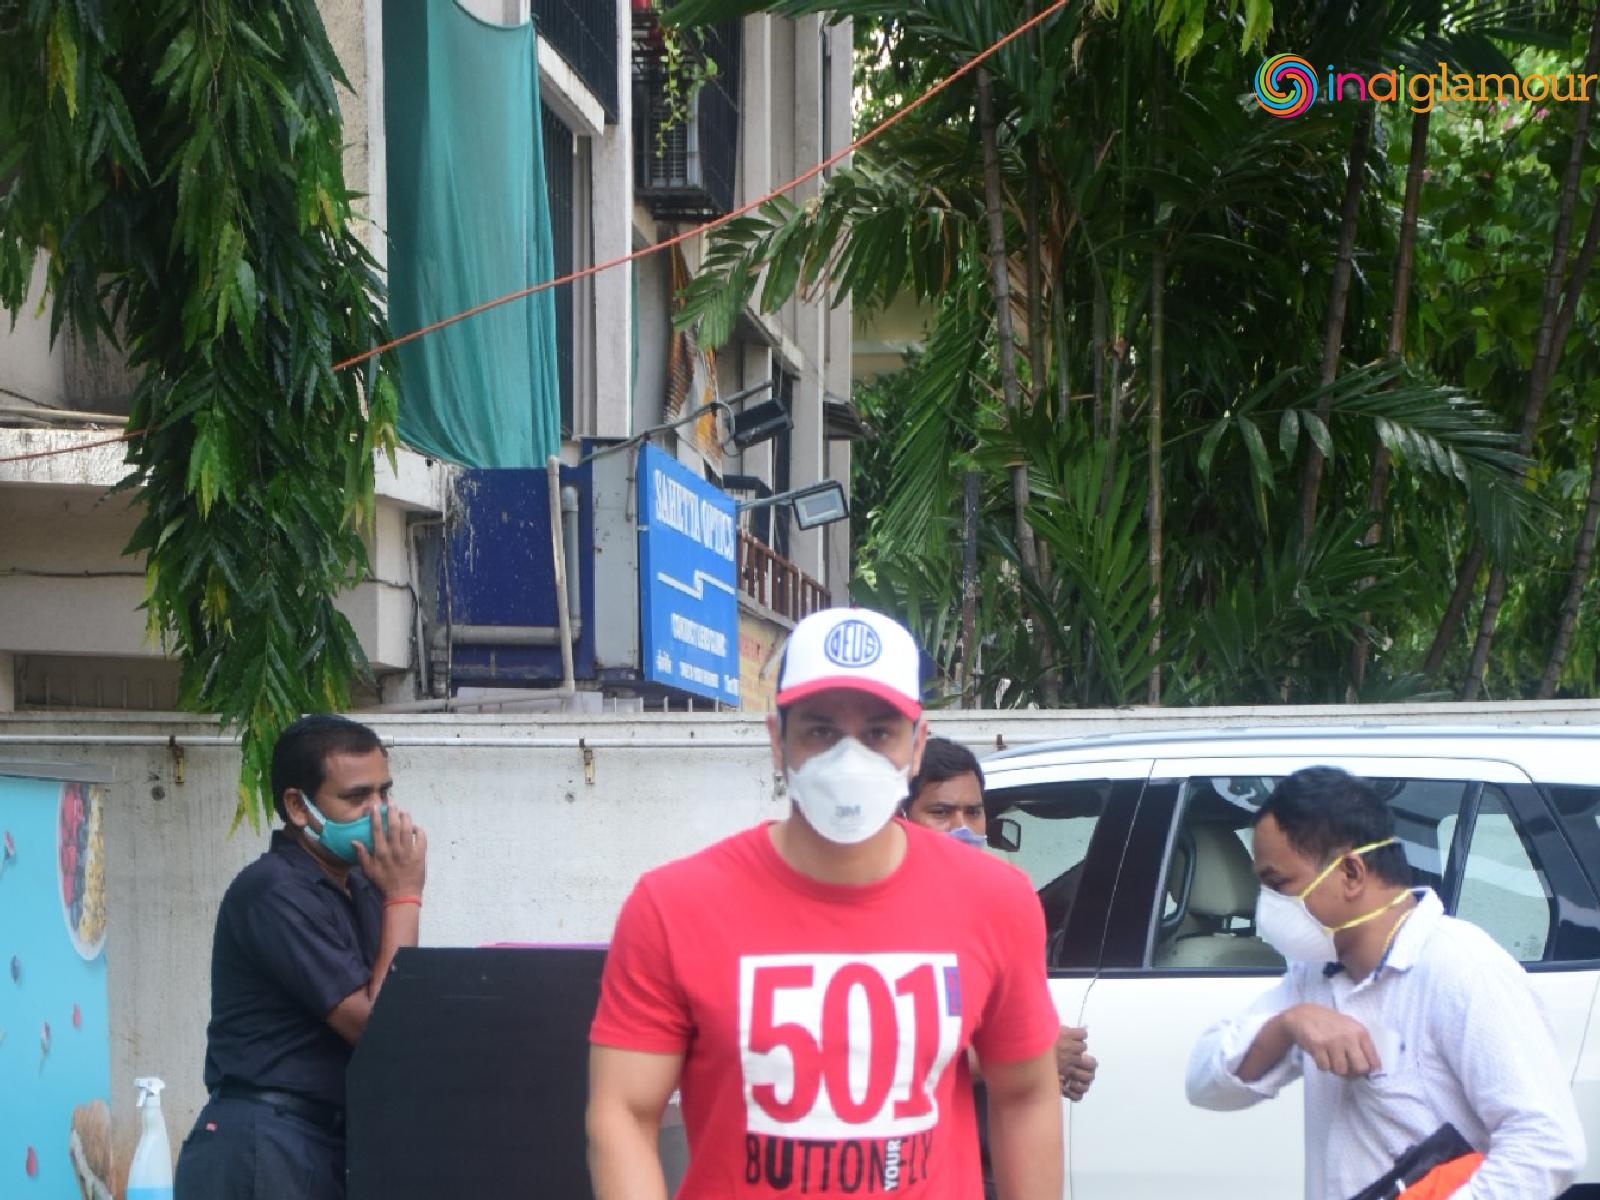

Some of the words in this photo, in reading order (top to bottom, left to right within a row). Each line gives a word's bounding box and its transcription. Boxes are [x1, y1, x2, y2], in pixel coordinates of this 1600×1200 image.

[750, 962, 939, 1124] 501
[745, 1134, 888, 1194] BUTTON
[884, 1138, 902, 1192] YOUR
